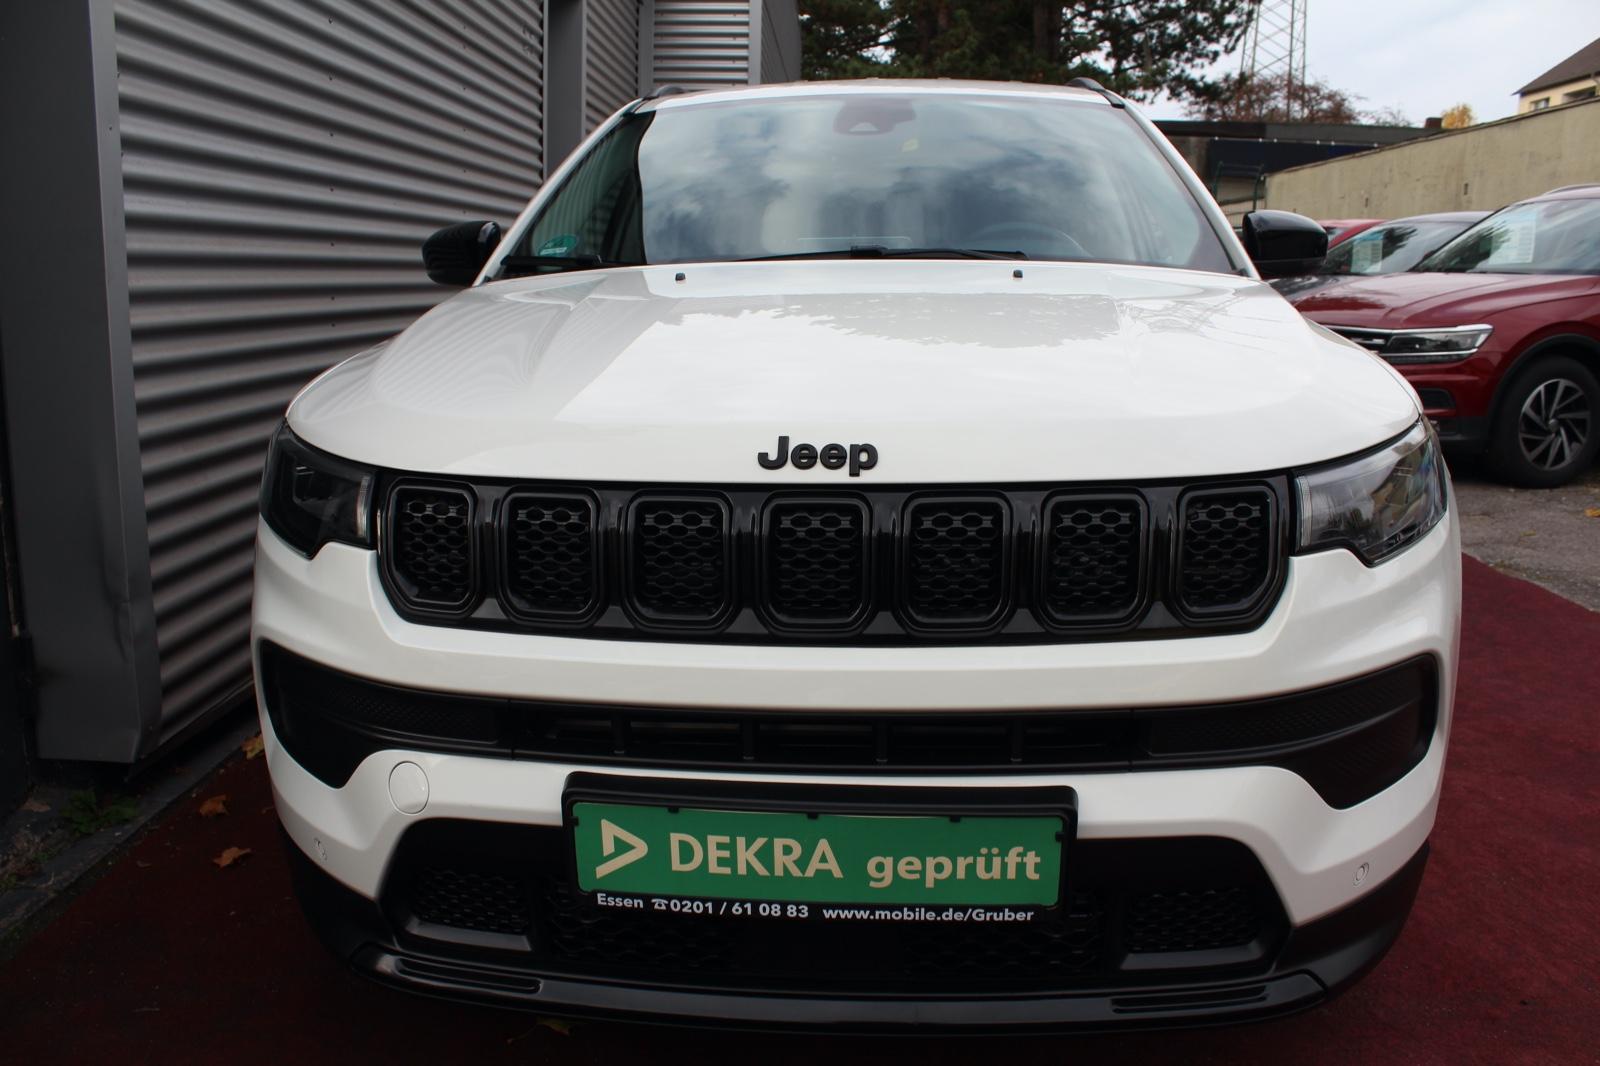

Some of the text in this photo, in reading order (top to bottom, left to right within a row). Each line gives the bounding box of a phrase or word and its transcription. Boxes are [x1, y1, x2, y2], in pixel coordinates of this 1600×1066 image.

[757, 435, 879, 477] Jeep
[669, 832, 1041, 889] DEKRA geprüft
[597, 893, 644, 909] Essen
[670, 899, 713, 915] 0201
[731, 902, 752, 916] 61
[759, 903, 782, 918] 08
[786, 904, 809, 918] 83
[823, 907, 1034, 922] www.mobile.de/Gruber
